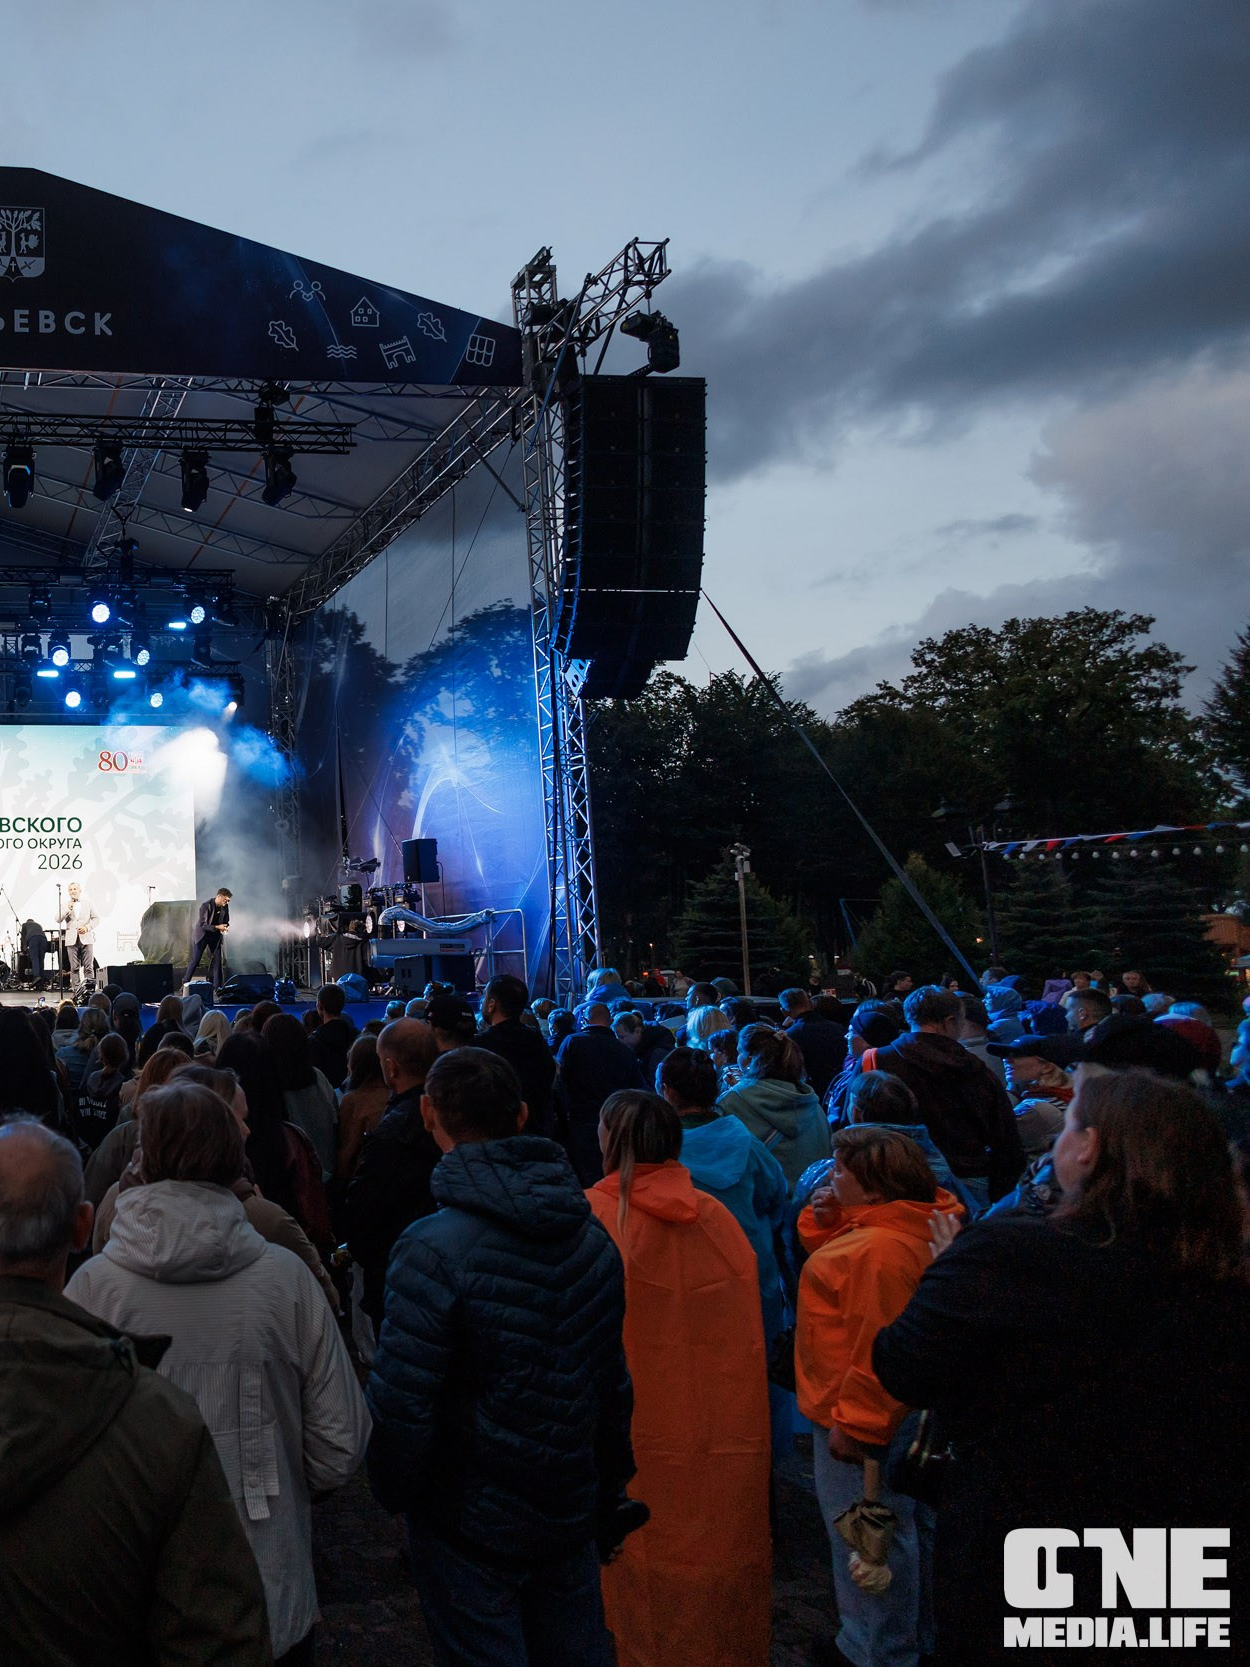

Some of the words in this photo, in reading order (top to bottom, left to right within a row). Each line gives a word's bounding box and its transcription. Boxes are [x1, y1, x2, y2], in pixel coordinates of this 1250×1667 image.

[98, 750, 128, 772] 80
[27, 838, 83, 849] ОКРУГА
[37, 853, 83, 870] 2026
